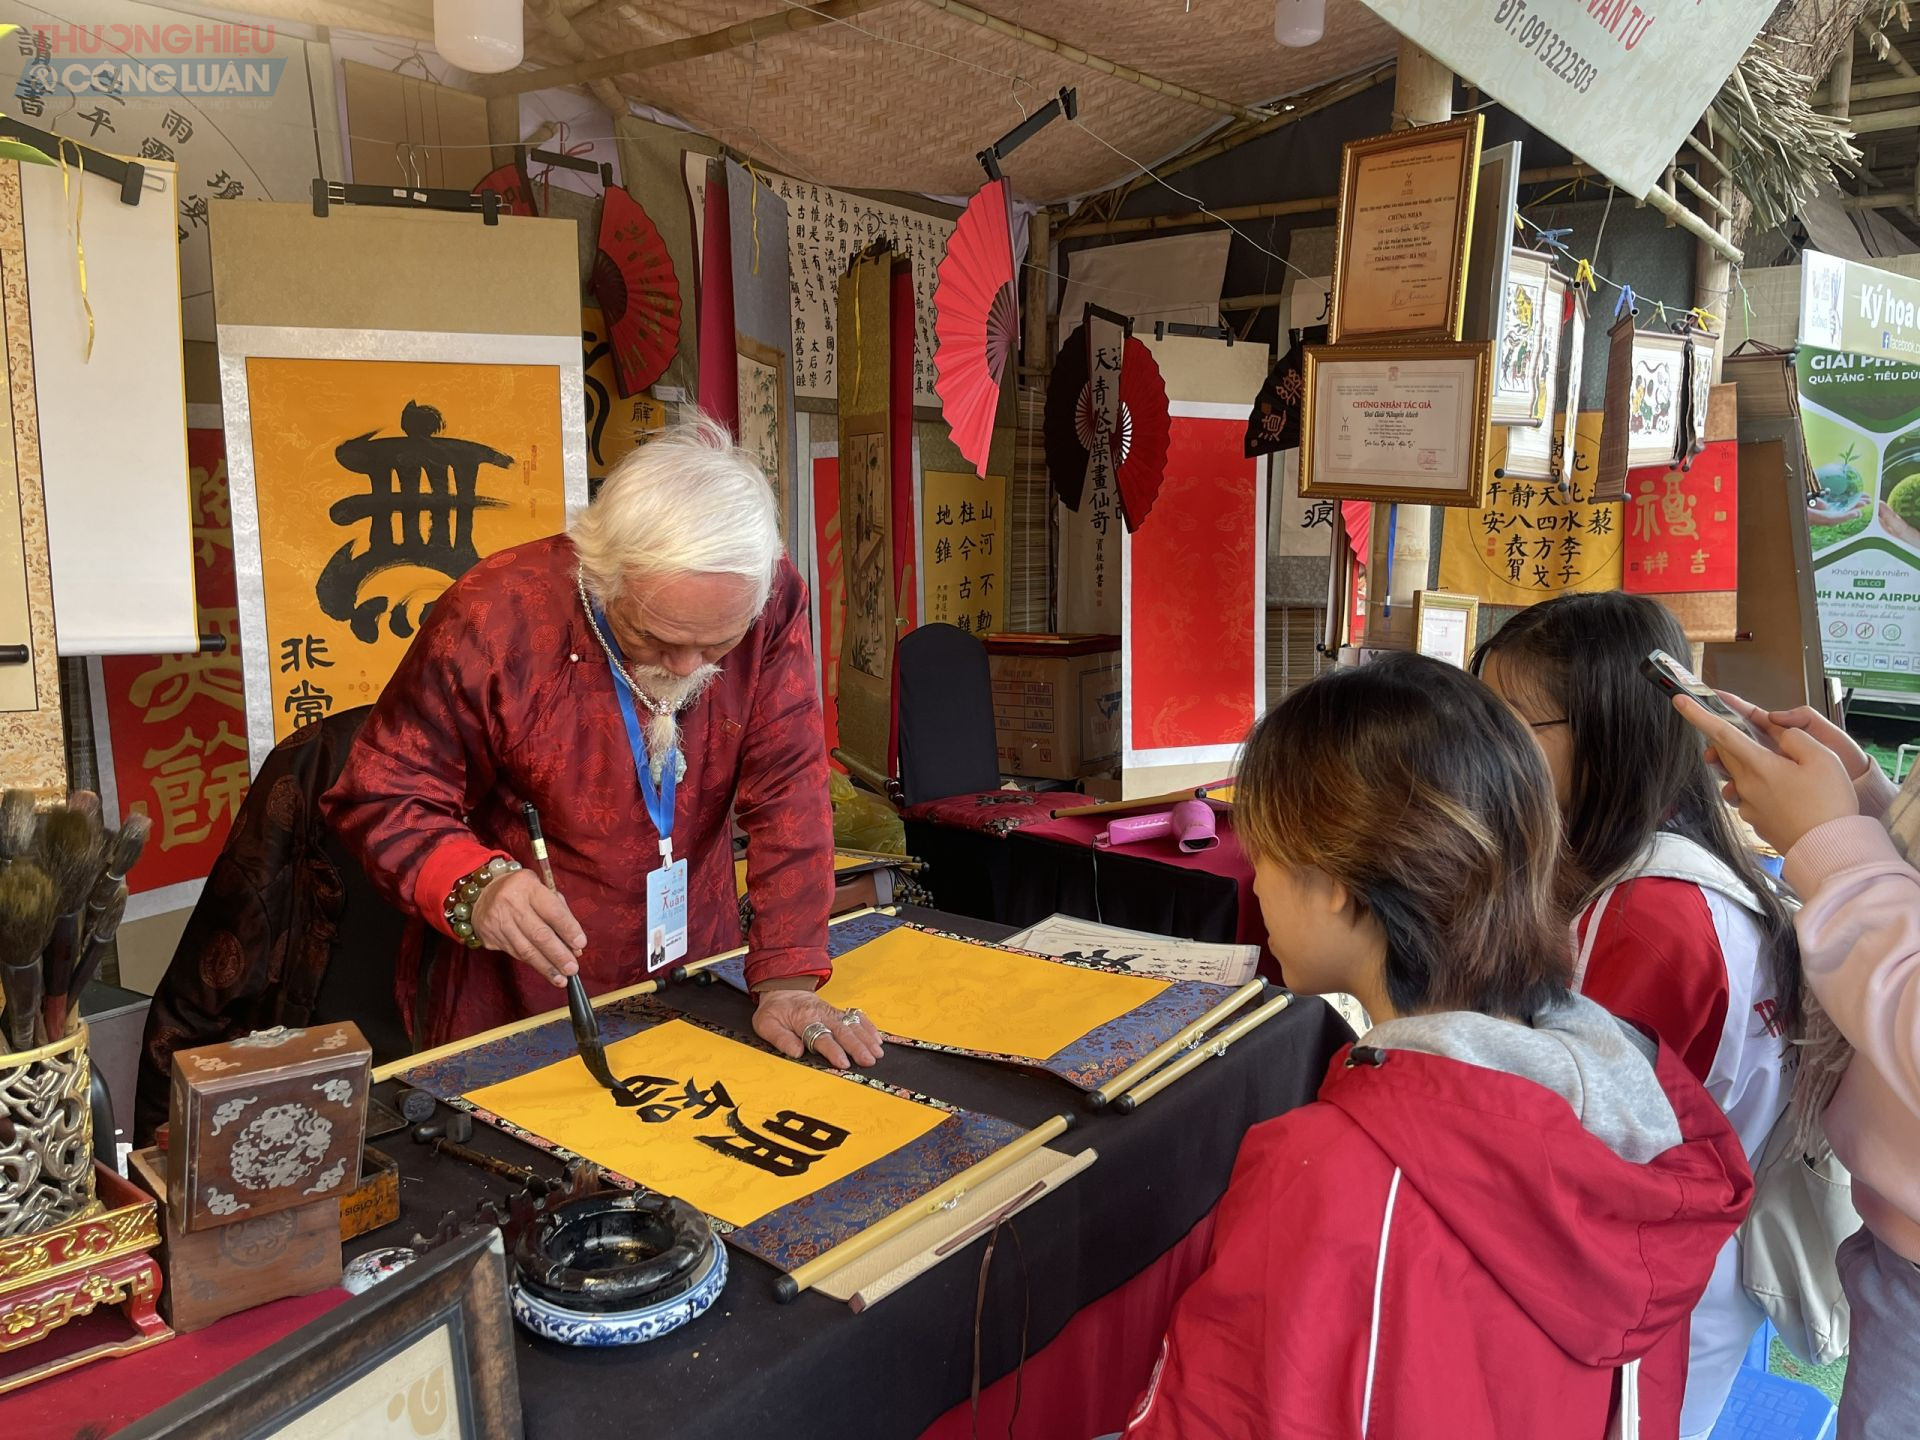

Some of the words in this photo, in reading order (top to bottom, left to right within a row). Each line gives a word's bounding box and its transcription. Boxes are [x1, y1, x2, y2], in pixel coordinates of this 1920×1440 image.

[1518, 14, 1598, 94] 0913222503
[1860, 283, 1884, 329] Ký
[1884, 288, 1915, 335] họa
[1808, 373, 1832, 385] QUÀ
[1834, 372, 1865, 385] TẶNG
[1874, 370, 1899, 381] TIÊU
[1352, 400, 1379, 409] CHỨNG
[1380, 400, 1402, 410] NHẬN
[1403, 400, 1417, 409] TÁC
[1418, 400, 1432, 409] GIẢ
[1831, 568, 1859, 577] Không
[1835, 591, 1875, 600] NANO
